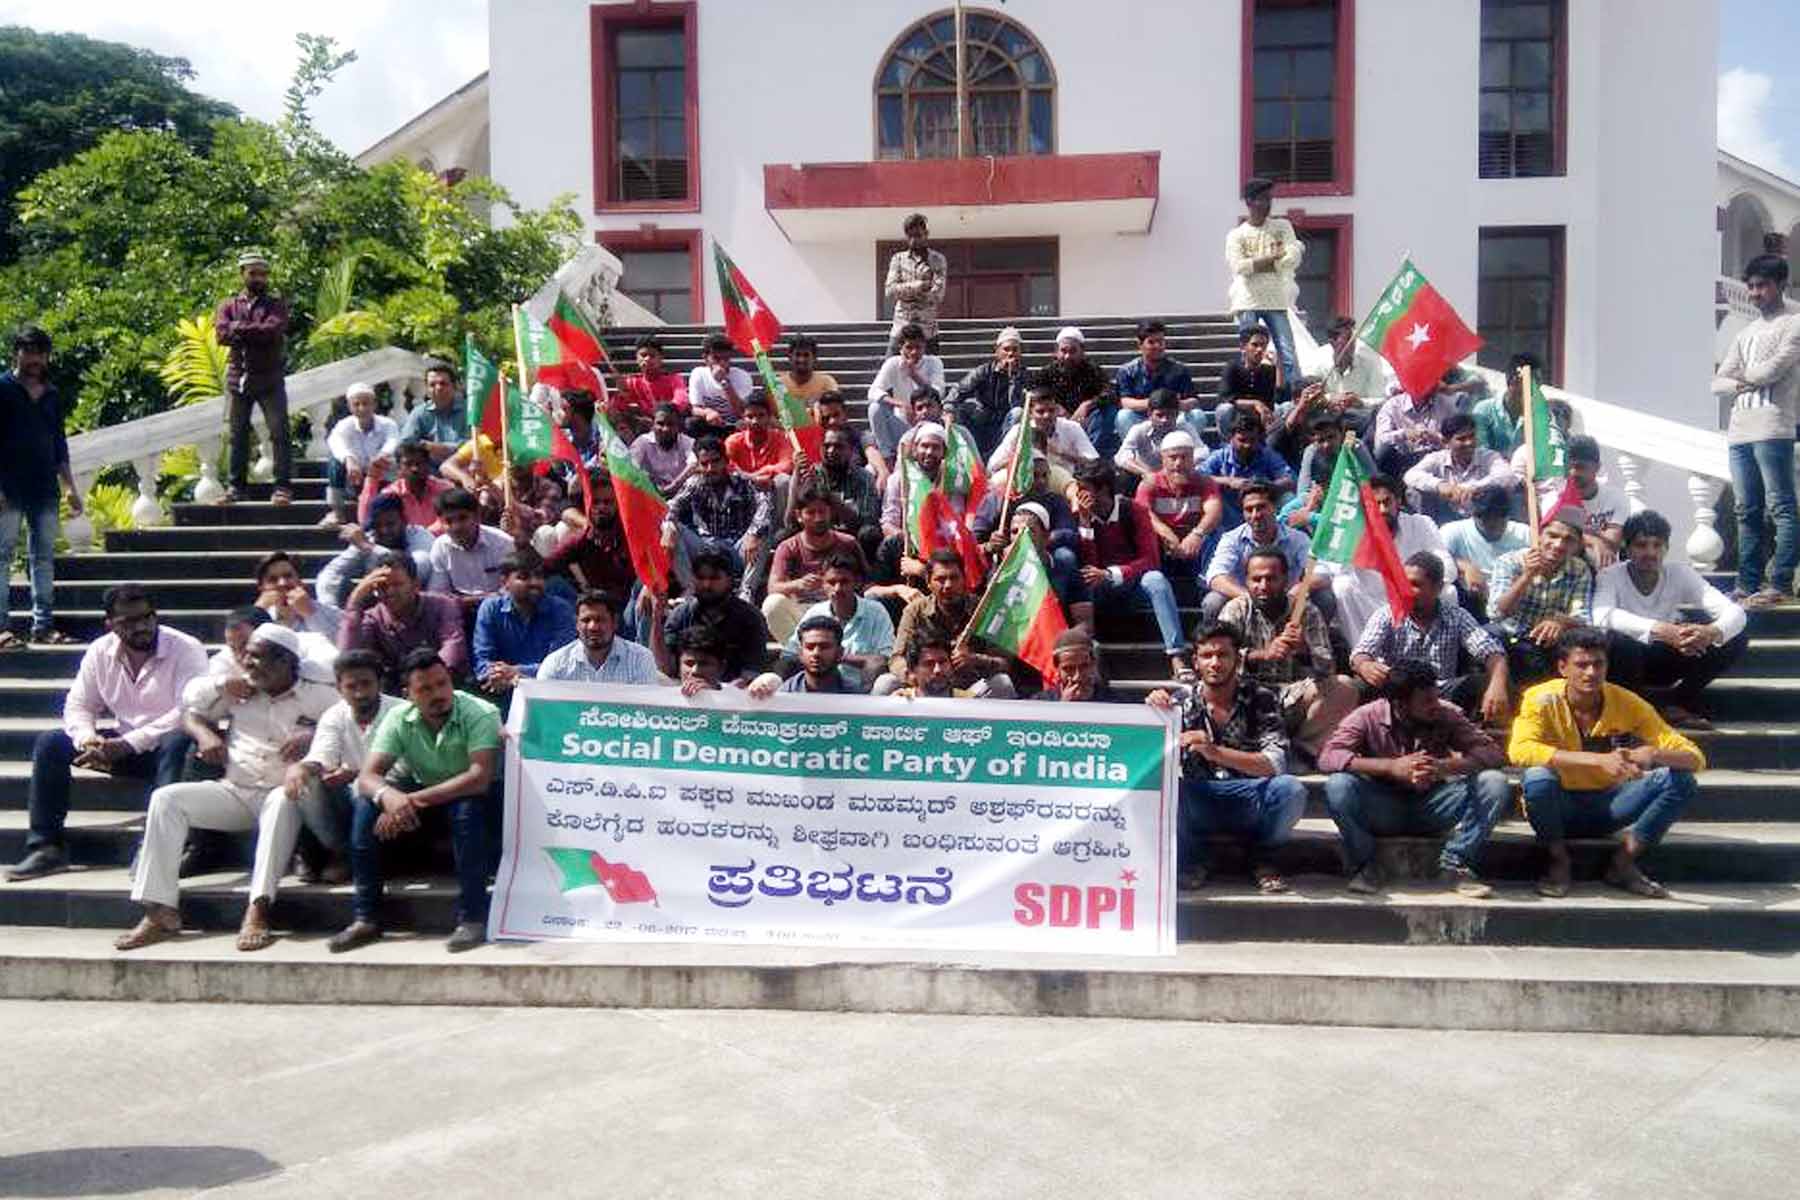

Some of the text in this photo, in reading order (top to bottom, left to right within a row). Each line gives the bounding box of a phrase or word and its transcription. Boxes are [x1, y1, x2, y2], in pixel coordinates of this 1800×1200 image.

[562, 732, 1128, 782] Social Democratic Party of India
[708, 857, 954, 908] ಪ್ರತಿಭಟನೆ
